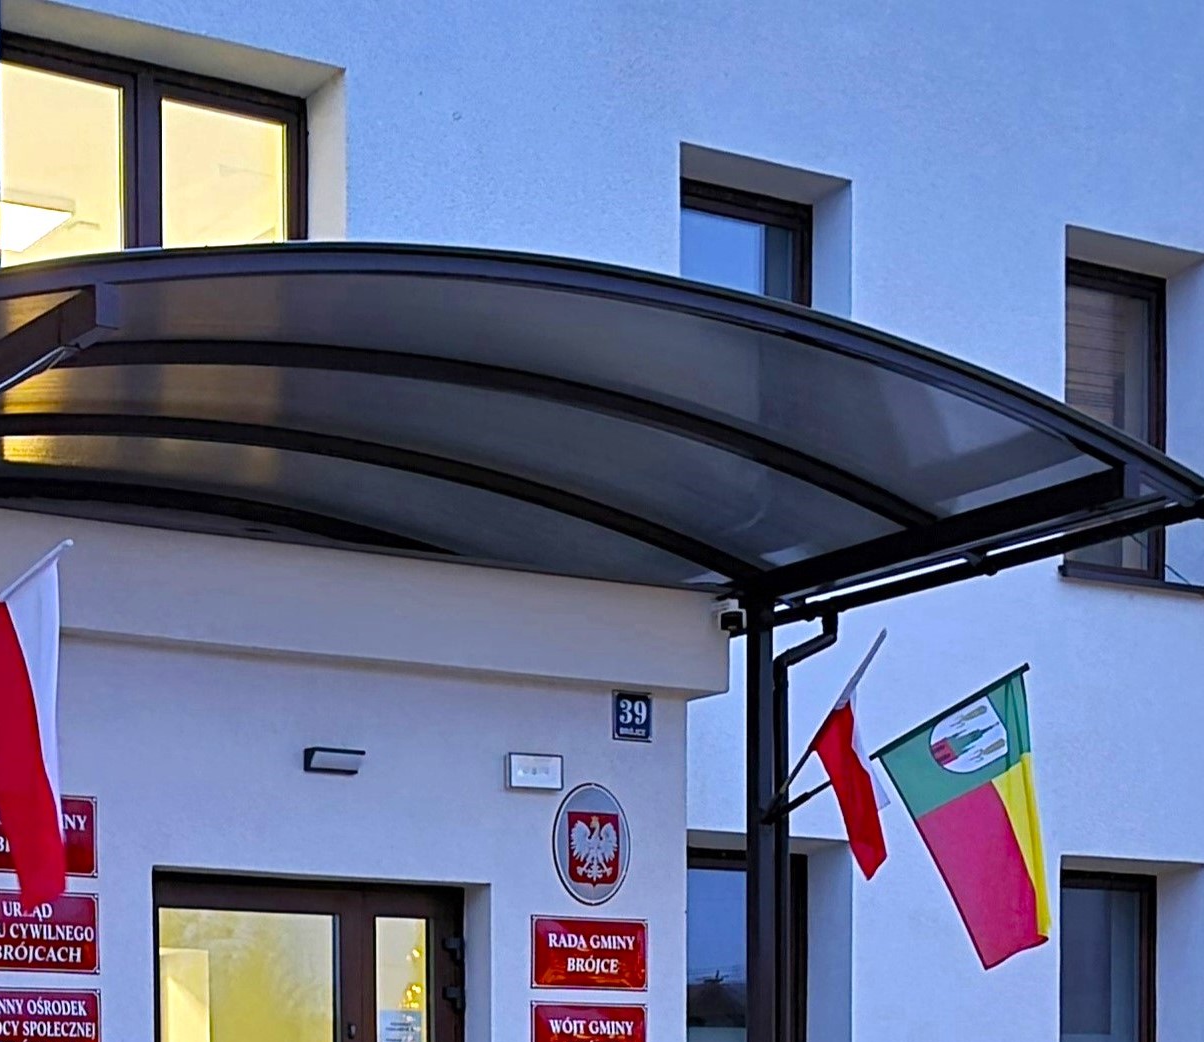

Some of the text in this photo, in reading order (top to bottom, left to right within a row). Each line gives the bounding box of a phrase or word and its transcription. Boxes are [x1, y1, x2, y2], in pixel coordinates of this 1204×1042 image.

[619, 699, 647, 725] 39
[9, 923, 94, 942] CYWILNEGO
[548, 933, 635, 950] RADA GMINY
[567, 955, 619, 974] BRÓJCE
[26, 996, 87, 1016] OŚRODEK
[22, 1020, 96, 1040] SPOŁECZNEJ
[548, 1017, 634, 1036] WÓJT GMINY
